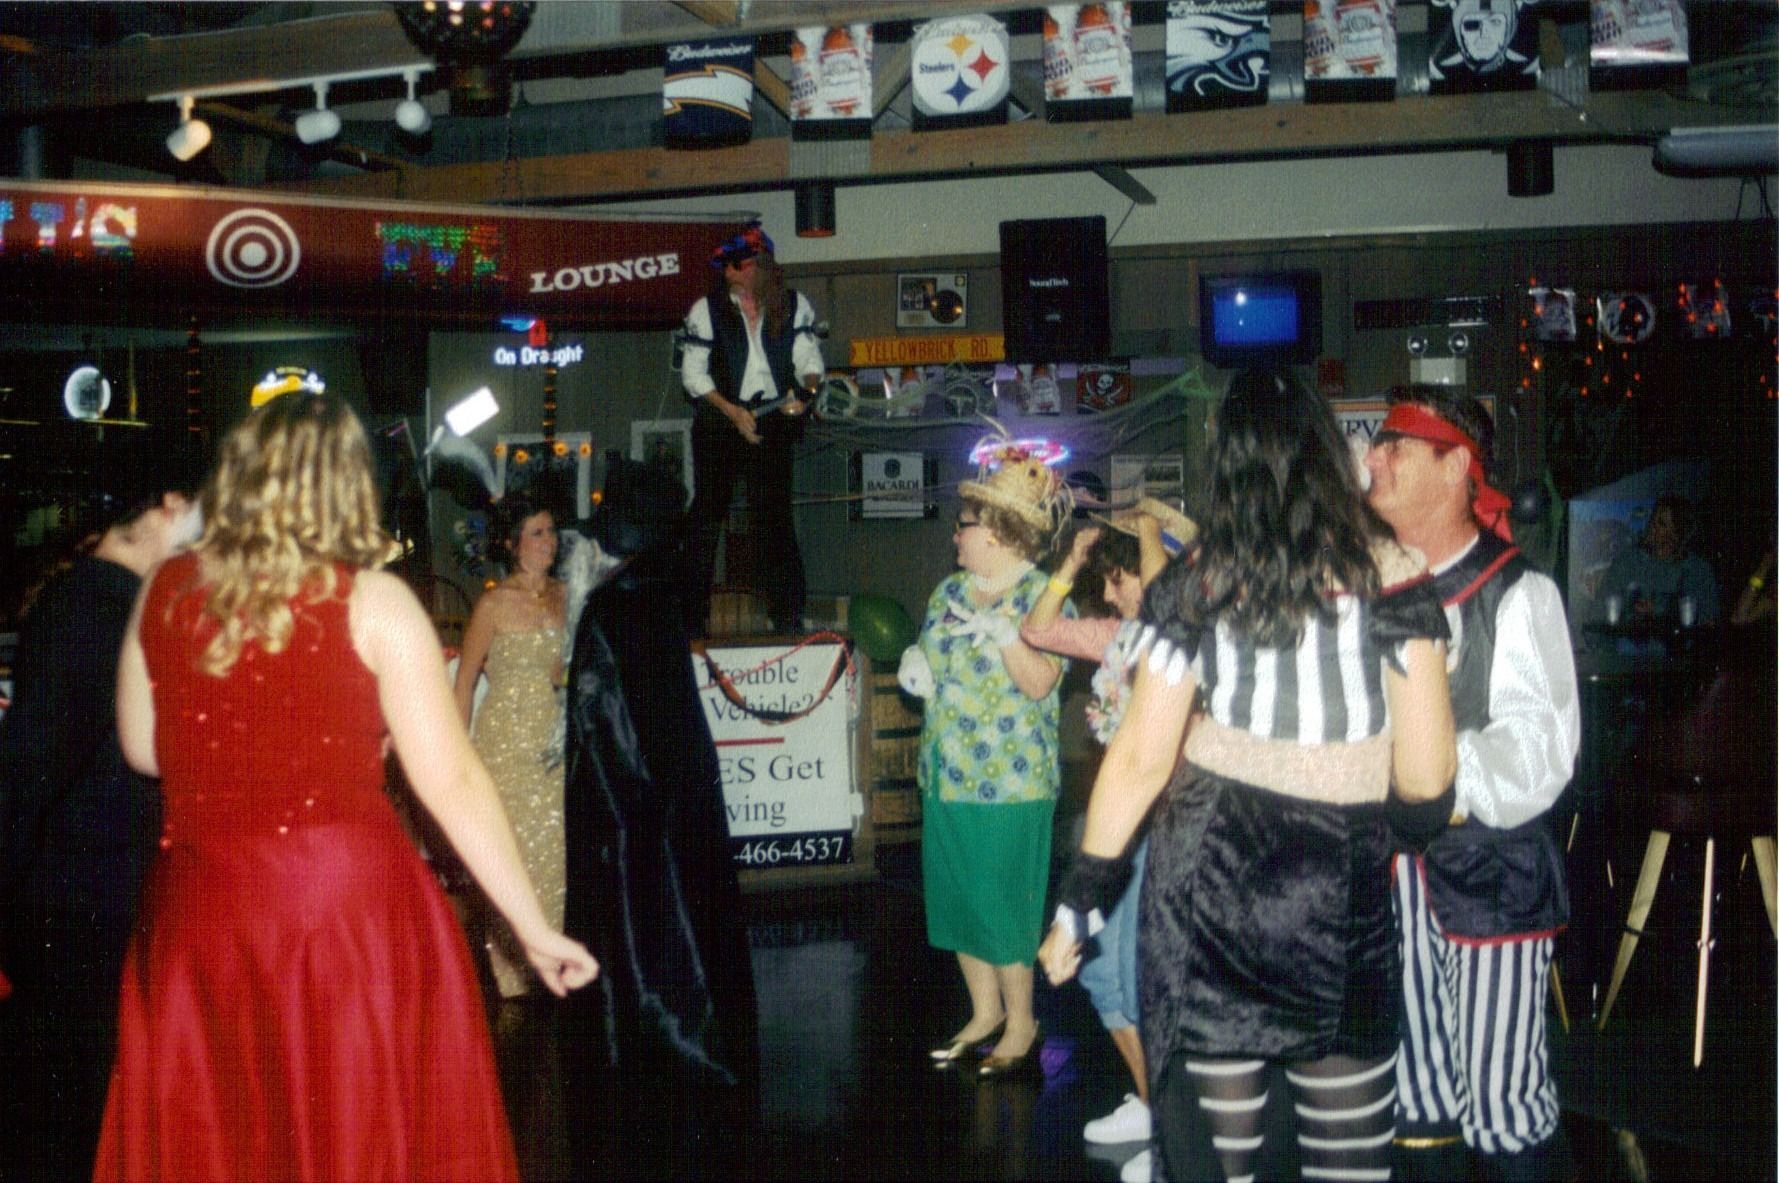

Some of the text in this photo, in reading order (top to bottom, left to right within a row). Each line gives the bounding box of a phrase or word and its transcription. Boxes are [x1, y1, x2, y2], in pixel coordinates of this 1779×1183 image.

[919, 62, 955, 75] Steelers
[530, 253, 680, 294] LOUNGE
[494, 346, 517, 366] On
[867, 480, 920, 491] BACARDI
[769, 754, 825, 782] Get
